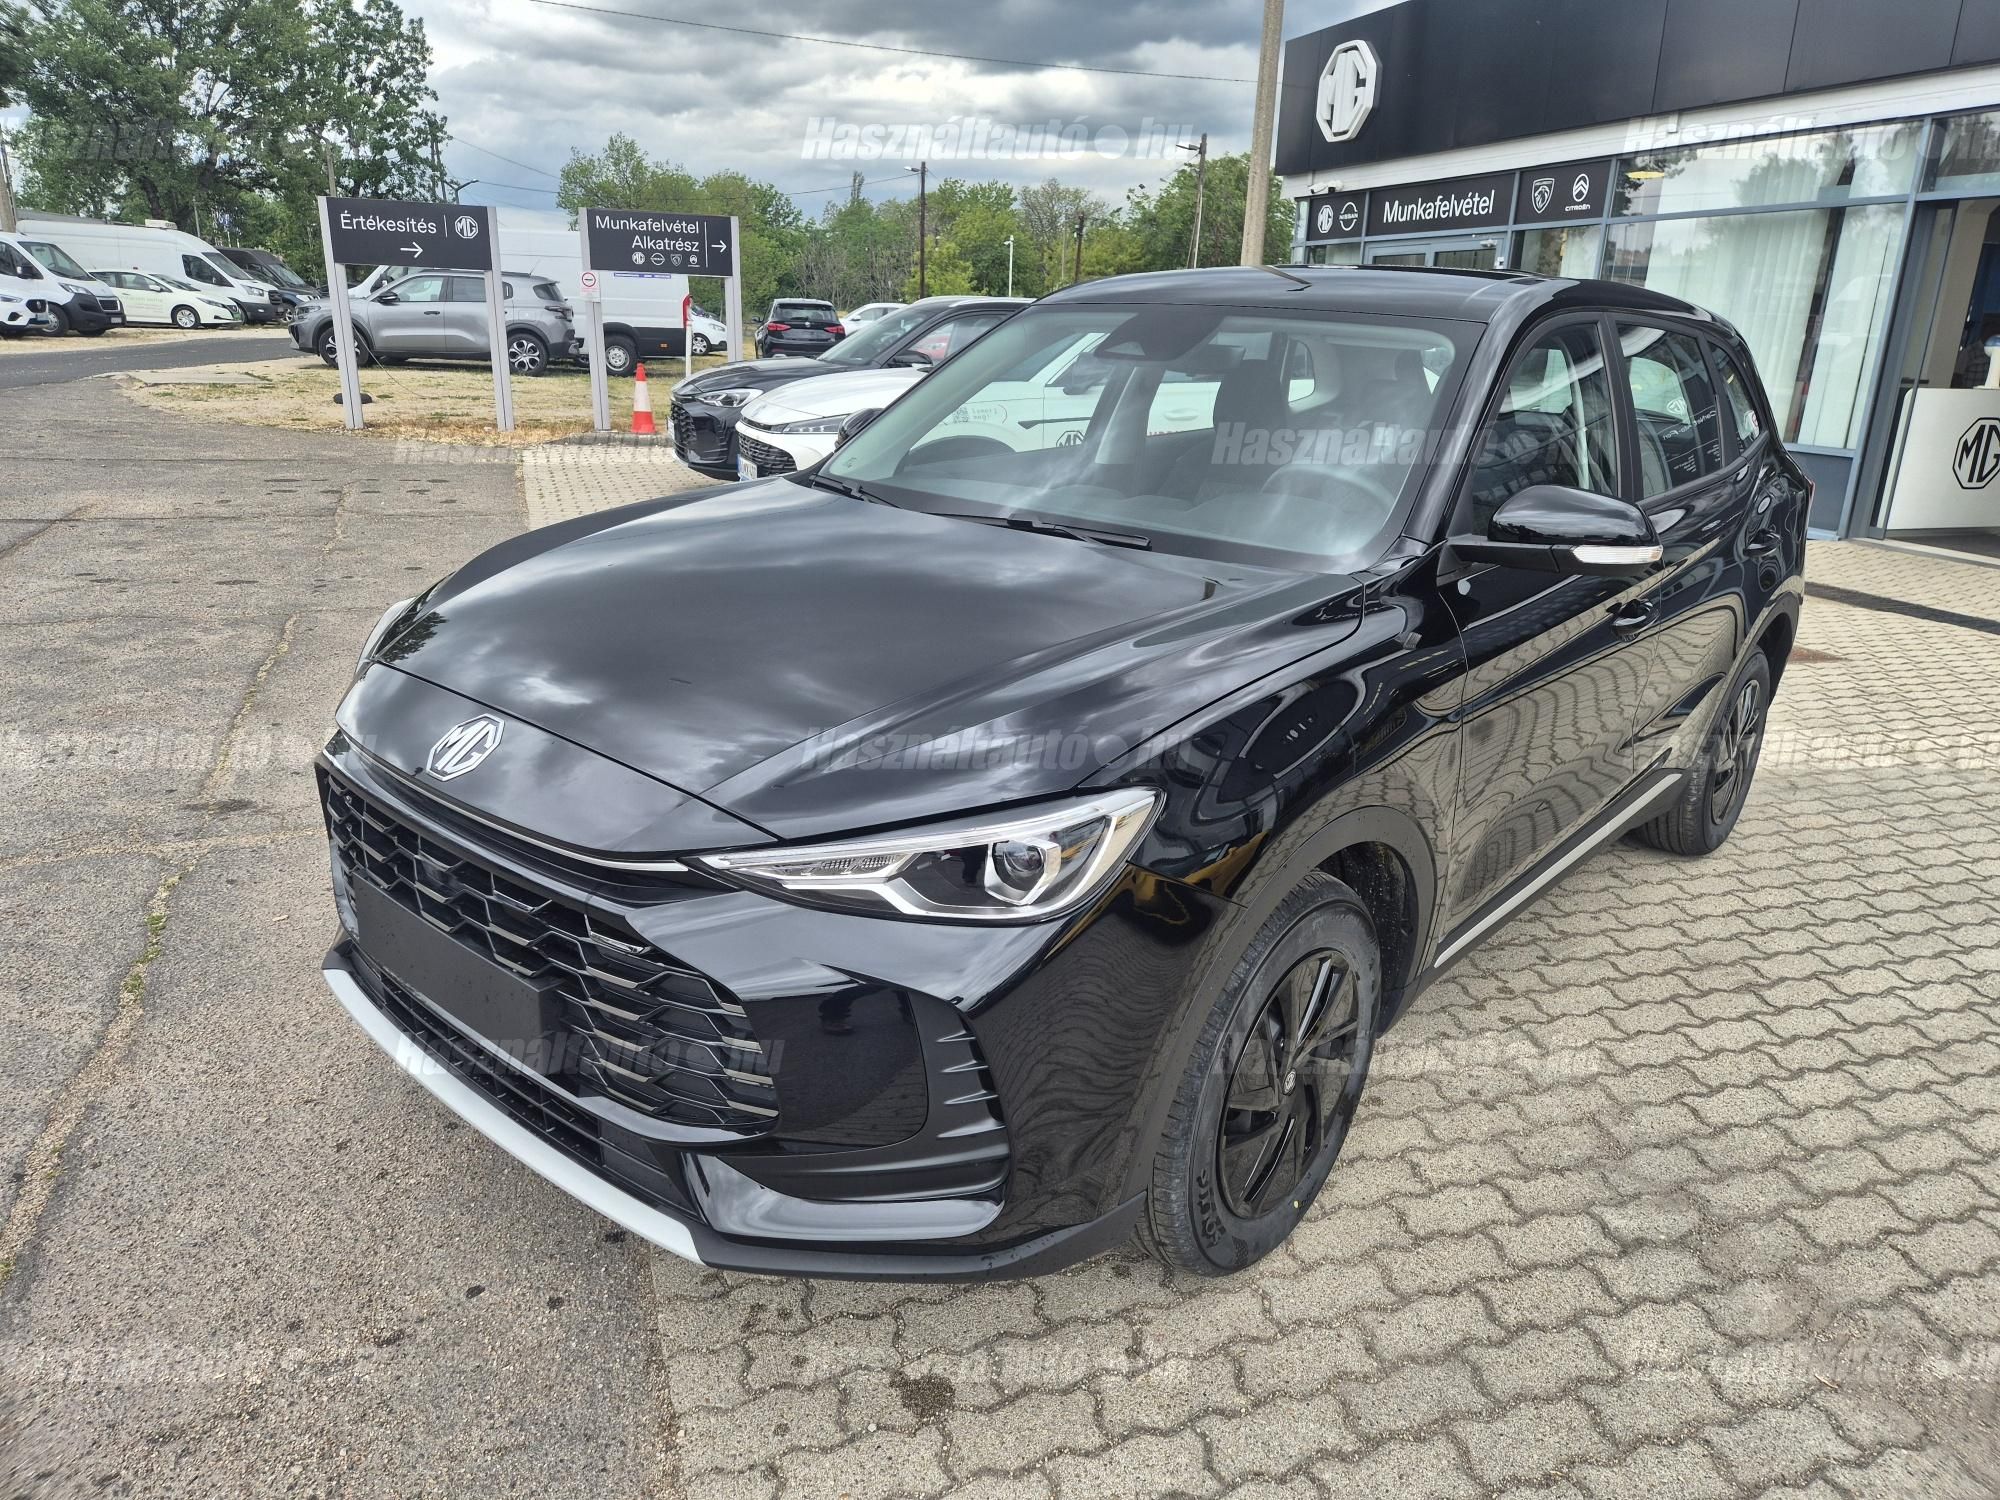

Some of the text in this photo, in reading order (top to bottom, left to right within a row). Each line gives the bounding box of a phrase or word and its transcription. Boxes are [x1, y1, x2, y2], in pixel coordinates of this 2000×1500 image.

[1317, 42, 1375, 140] MG
[1383, 189, 1495, 223] Munkafelvétel
[340, 210, 437, 234] Értékesítés
[456, 217, 477, 238] MG
[595, 215, 699, 234] Munkafelvétel
[631, 235, 699, 252] Alkatrész
[1955, 420, 2000, 487] MG
[428, 715, 503, 778] MG
